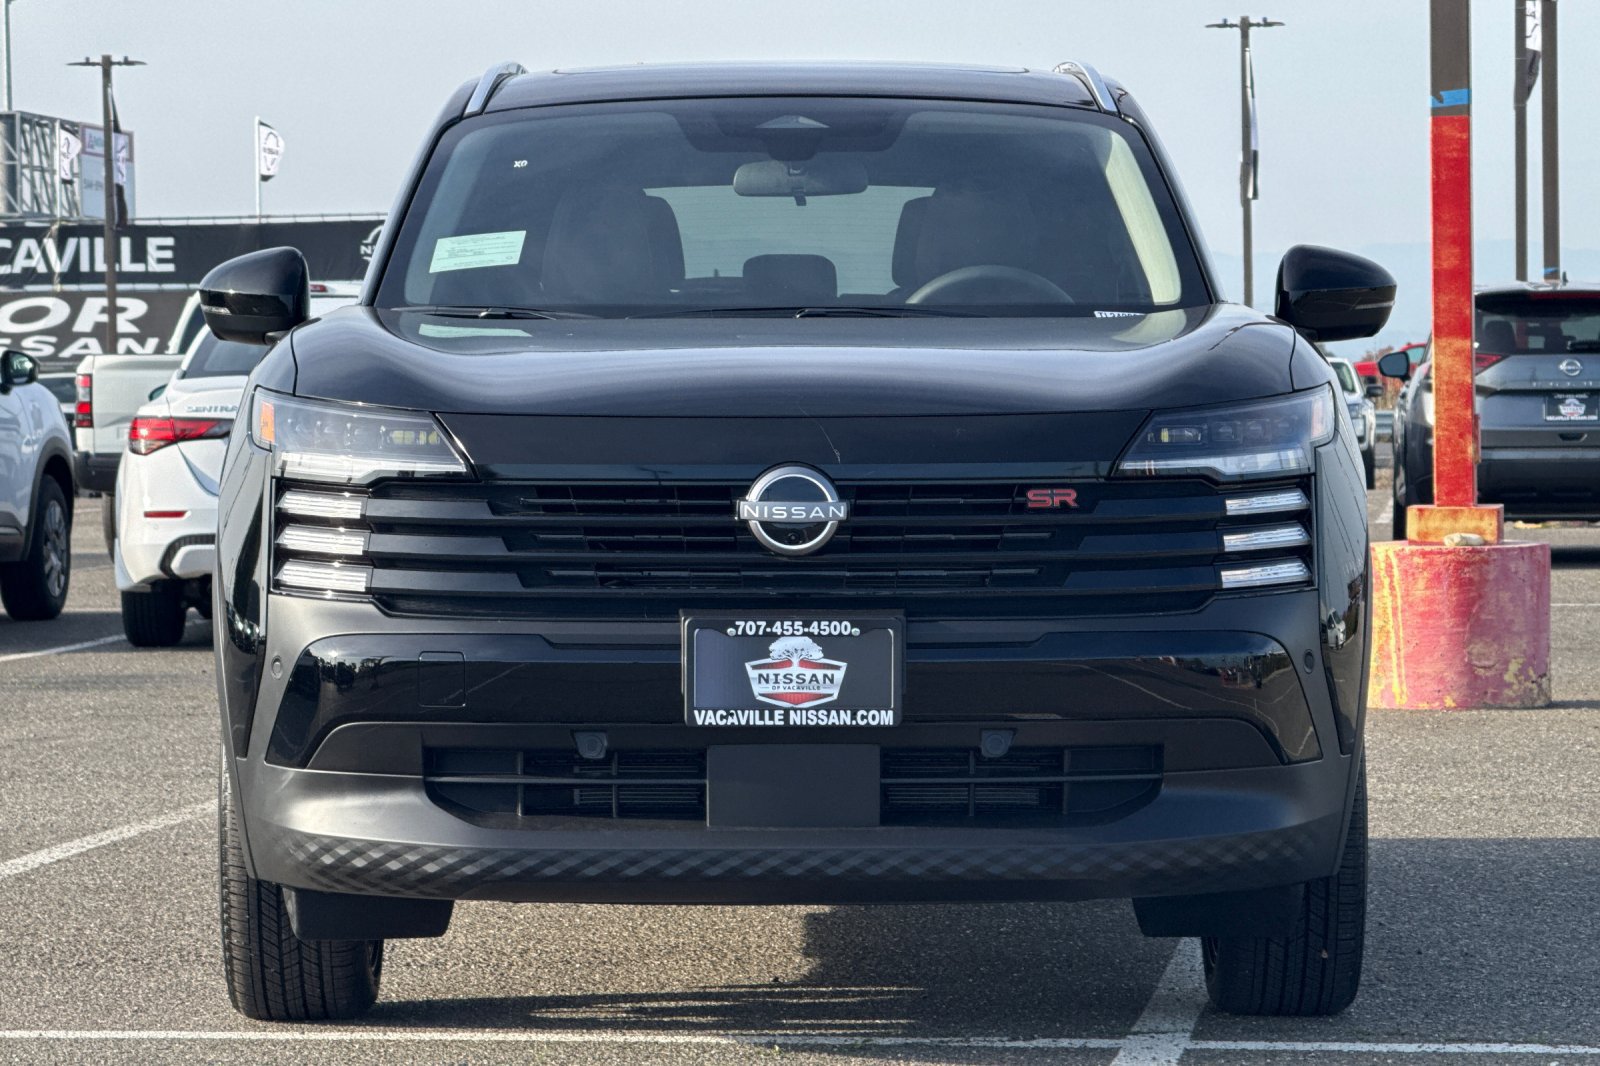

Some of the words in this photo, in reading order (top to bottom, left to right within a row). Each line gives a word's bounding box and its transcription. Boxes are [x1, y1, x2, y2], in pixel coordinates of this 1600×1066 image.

[1026, 489, 1079, 507] SR
[743, 505, 845, 519] NISSAN
[734, 620, 852, 636] 707-455-4500
[757, 672, 835, 685] NISSAN
[693, 709, 785, 726] VACAVILLE
[789, 709, 894, 726] NISSAN.COM
